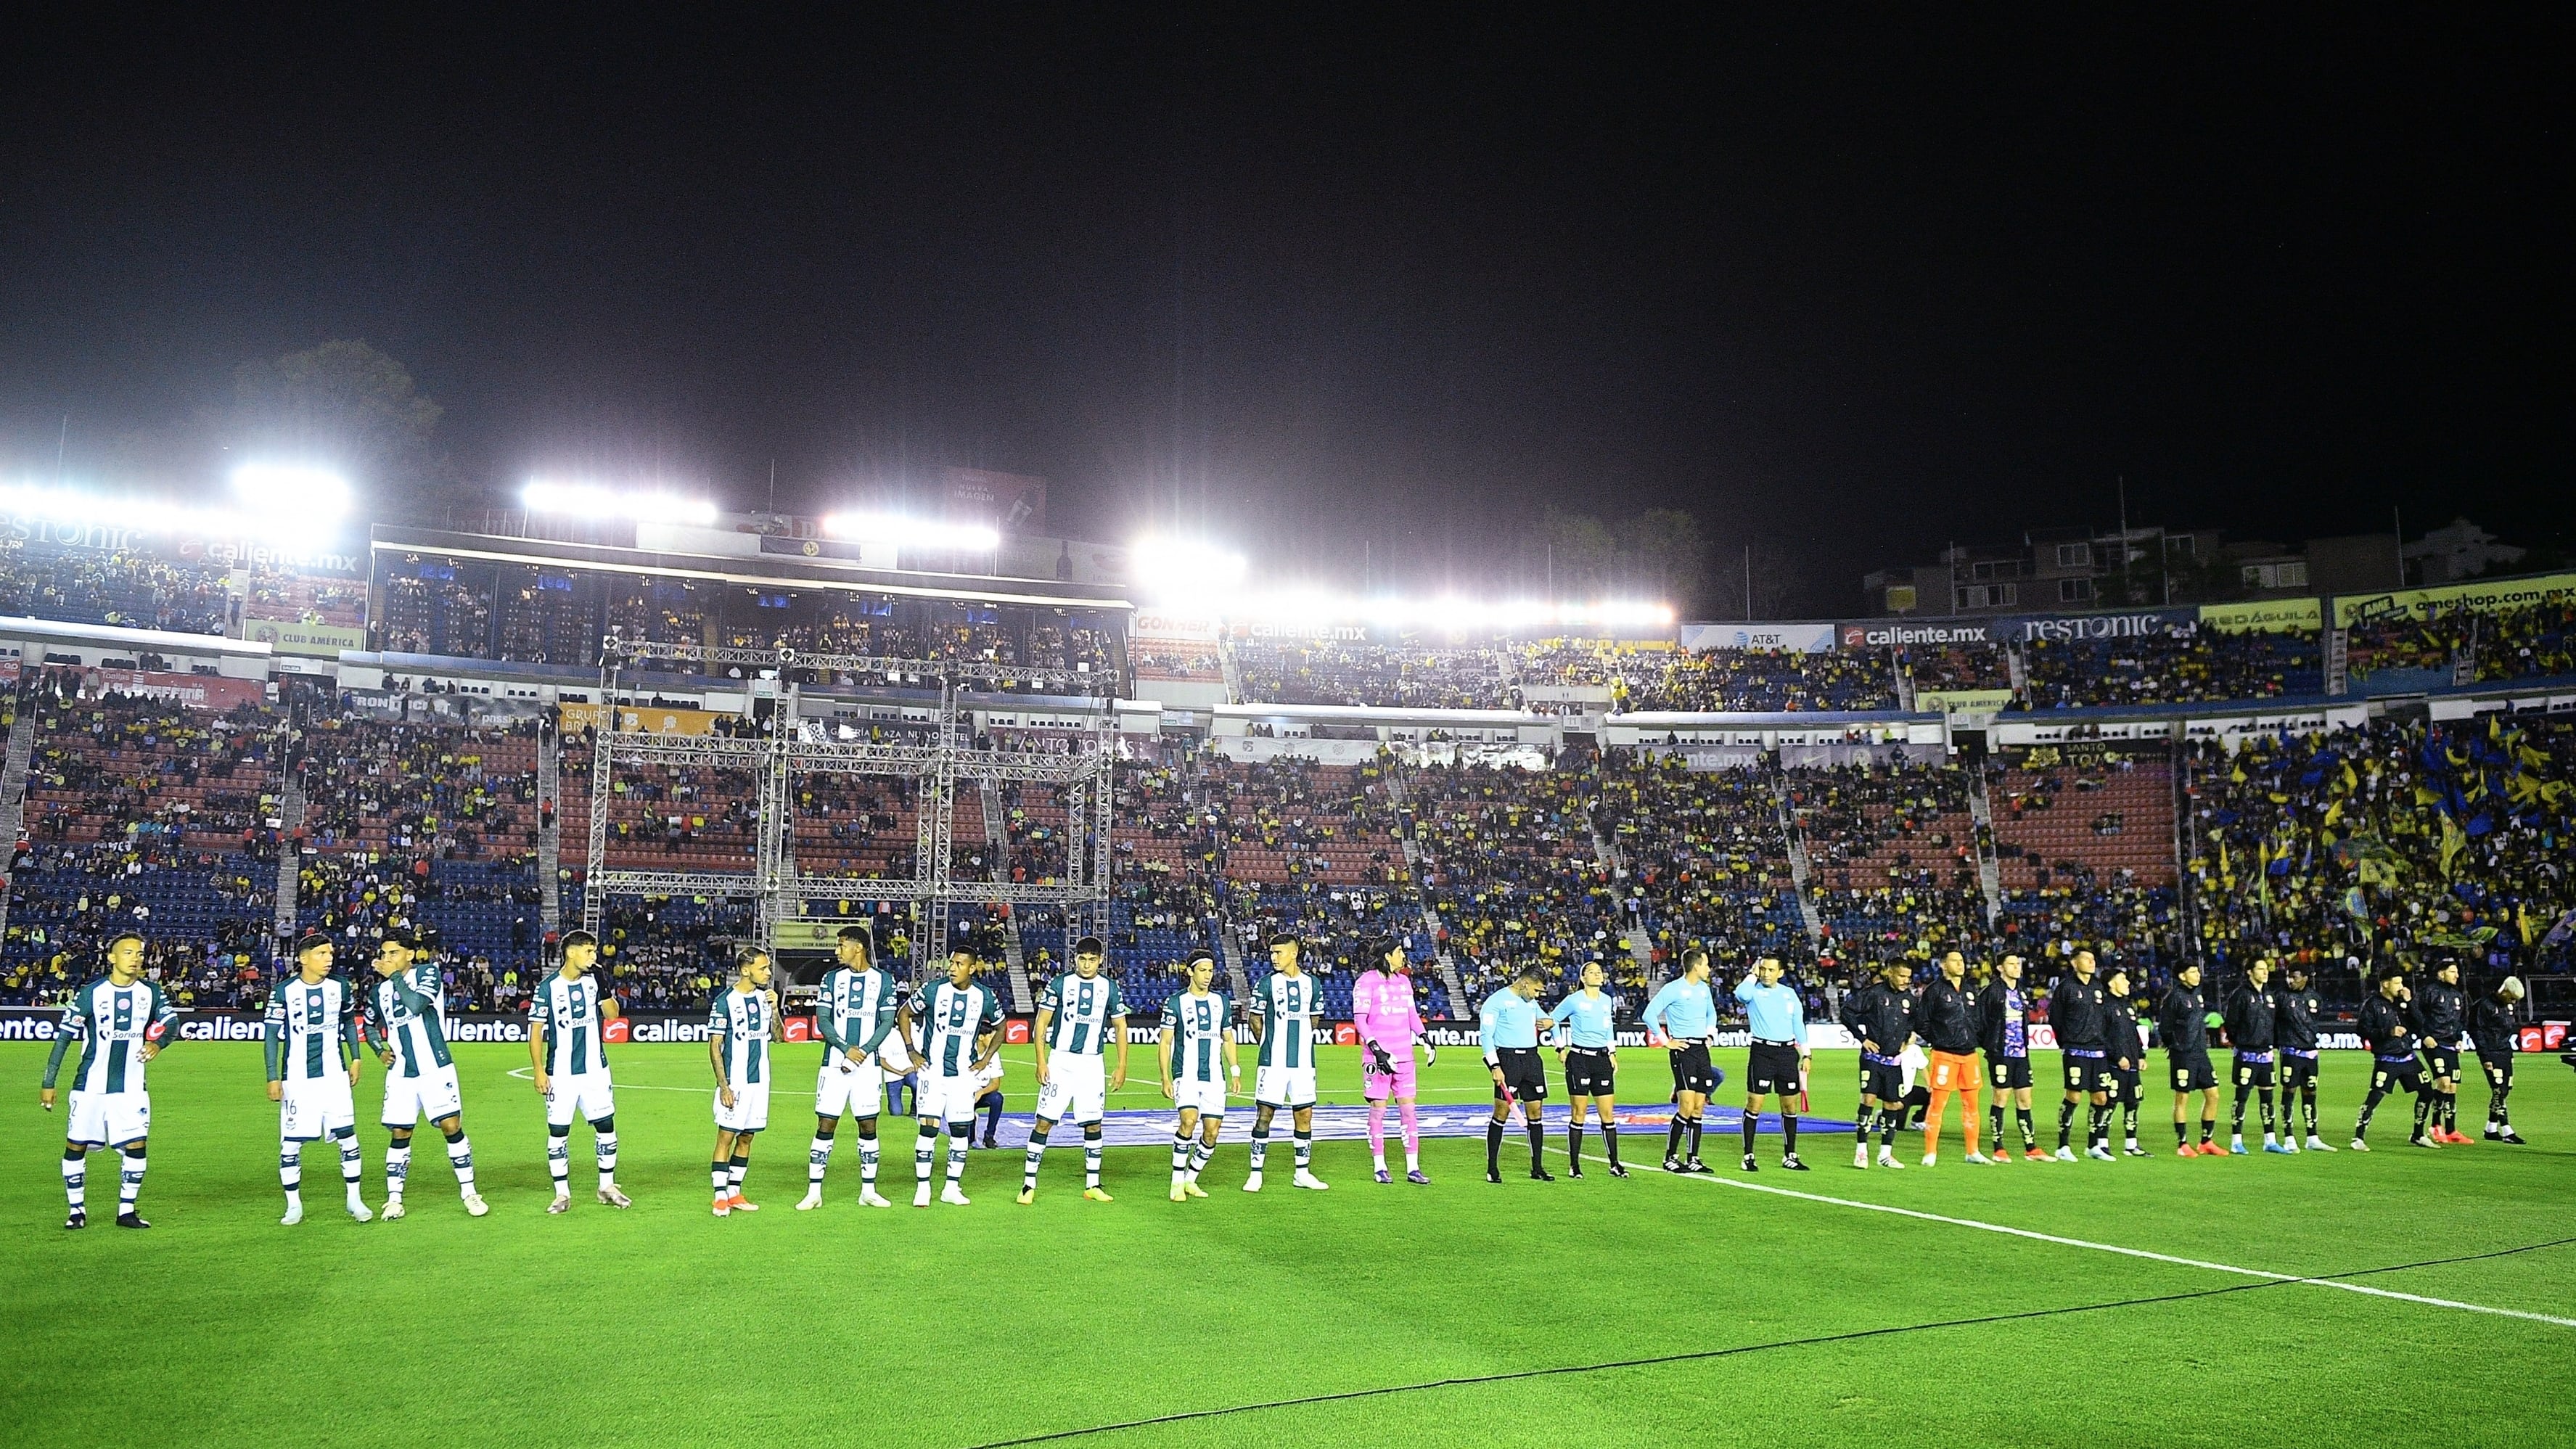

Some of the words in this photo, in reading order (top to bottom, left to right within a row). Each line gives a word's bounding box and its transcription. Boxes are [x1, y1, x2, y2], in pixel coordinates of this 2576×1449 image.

[954, 490, 994, 501] IMAGEN
[283, 633, 307, 643] CLUB
[310, 634, 355, 648] AMÉRICA
[1751, 634, 1780, 645] AT&T
[1866, 627, 1986, 644] caliente.mx
[102, 671, 130, 681] Toallas
[2067, 742, 2106, 753] SANTO
[1260, 1068, 1266, 1083] 2
[2418, 1070, 2430, 1084] 19
[819, 1075, 826, 1091] 11
[920, 1080, 930, 1094] 18
[284, 1099, 297, 1116] 16
